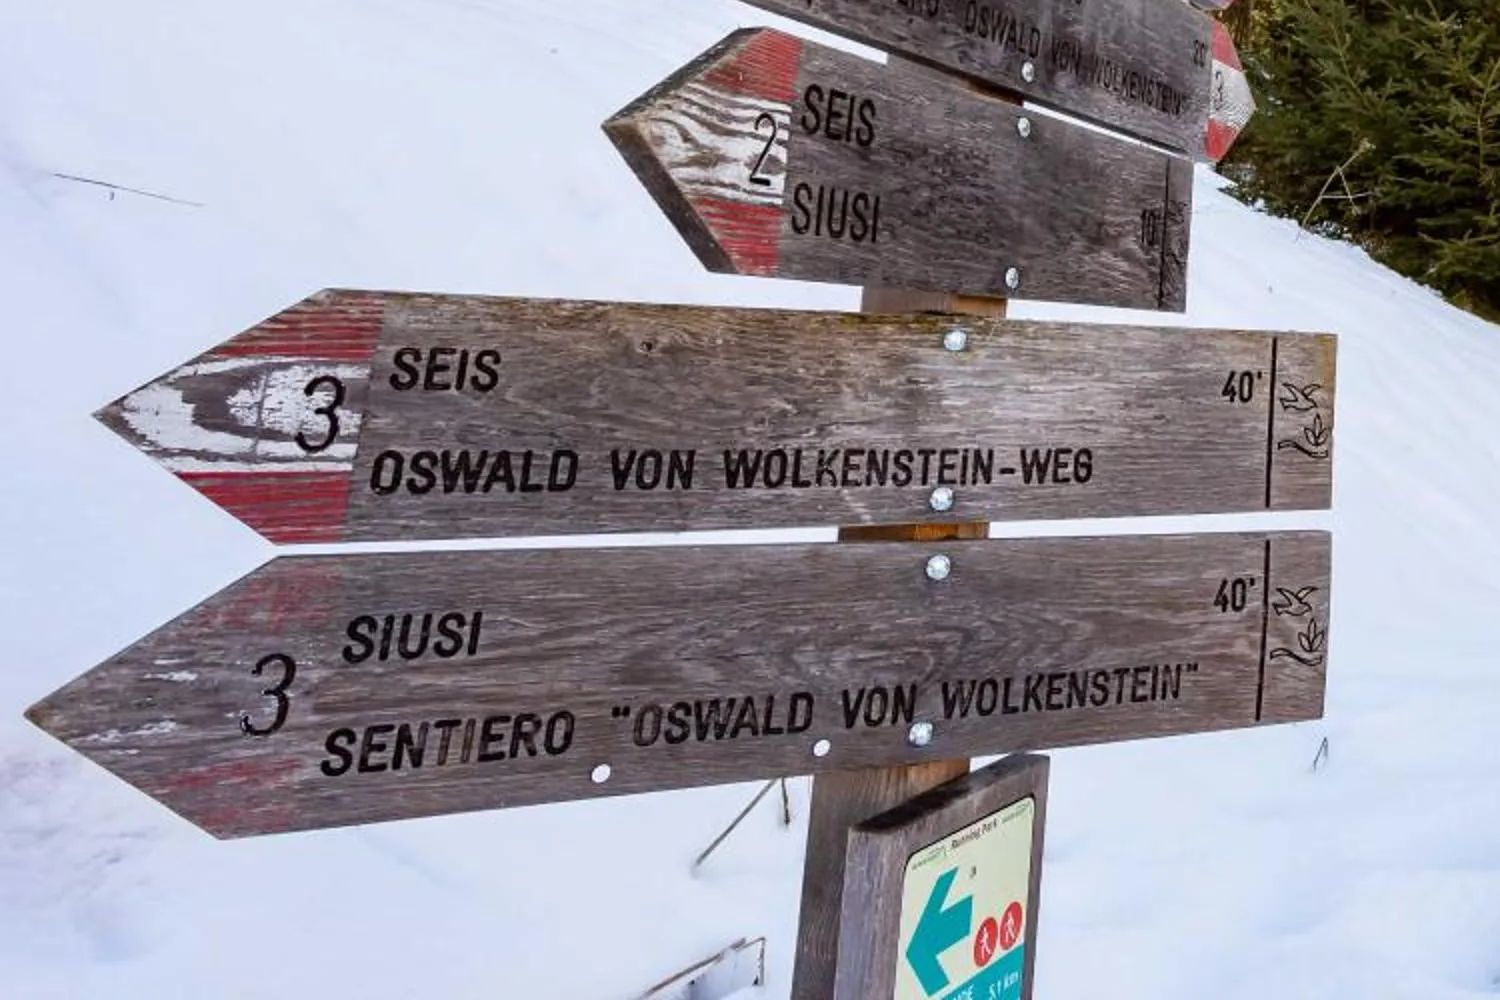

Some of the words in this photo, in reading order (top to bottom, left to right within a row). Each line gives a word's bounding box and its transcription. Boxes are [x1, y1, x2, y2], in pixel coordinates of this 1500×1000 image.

[1051, 37, 1081, 76] VON
[801, 83, 876, 147] SEIS
[750, 112, 777, 186] 2
[791, 182, 880, 243] SIUSI
[389, 347, 501, 392] SEIS
[1221, 370, 1263, 403] 40'
[294, 375, 346, 452] 3
[369, 449, 579, 495] OSWALD
[610, 449, 697, 490] VON
[723, 447, 1093, 489] WOLKENSTEIN-WEG
[1213, 577, 1256, 613] 40'
[342, 611, 482, 663] SIUSI
[240, 653, 296, 736] 3
[320, 709, 576, 777] SENTIERO
[611, 691, 814, 747] "OSWALD
[842, 684, 918, 729] VON
[942, 662, 1199, 720] WOLKENSTEIN"
